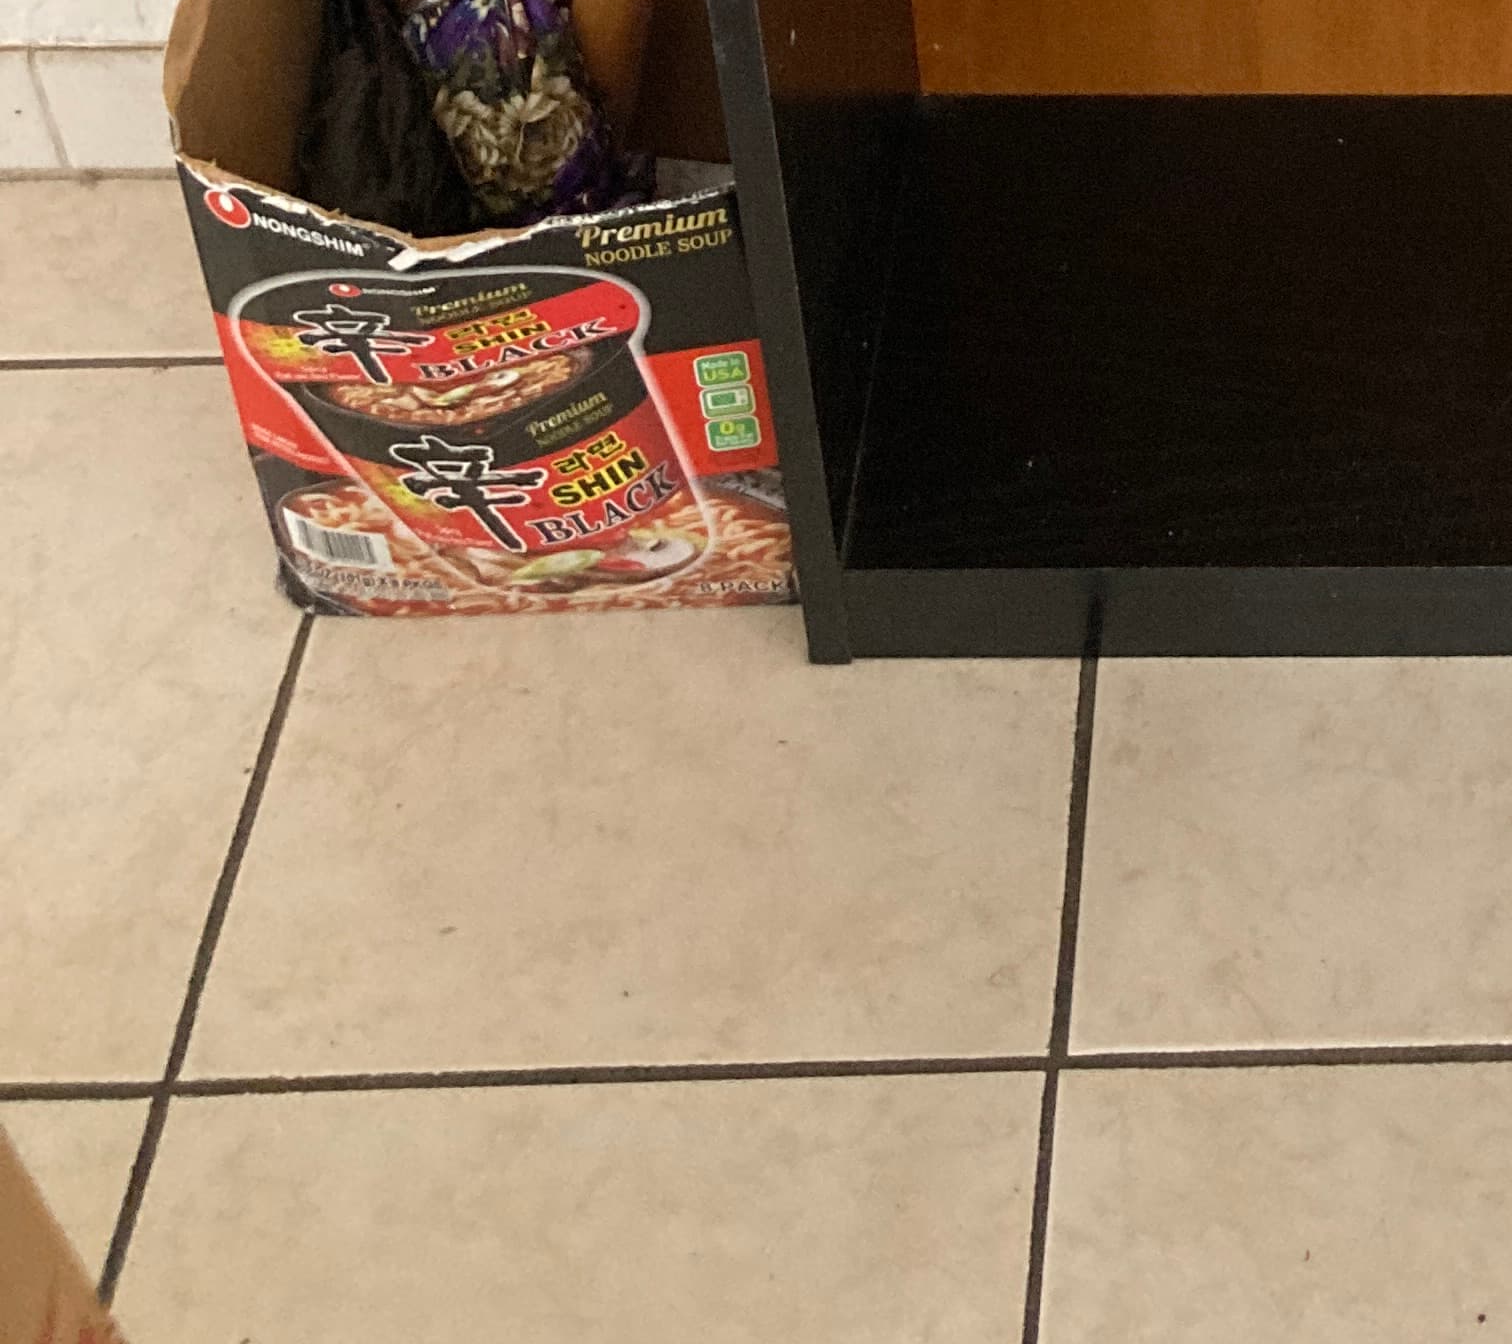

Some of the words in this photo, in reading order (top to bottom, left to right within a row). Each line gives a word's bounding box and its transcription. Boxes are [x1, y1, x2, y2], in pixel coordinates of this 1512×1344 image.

[253, 213, 365, 257] NONGSHIM
[575, 208, 728, 248] Premium
[585, 241, 672, 266] NOODLE
[677, 228, 733, 252] SOUP
[292, 304, 436, 385] 辛
[416, 317, 618, 381] BLACK
[453, 321, 552, 354] SHIN
[703, 367, 745, 382] USA
[525, 392, 607, 437] Premium
[551, 430, 627, 474] 라면
[390, 435, 548, 554] 辛
[550, 447, 650, 508] SHIN
[524, 463, 679, 546] BLACK
